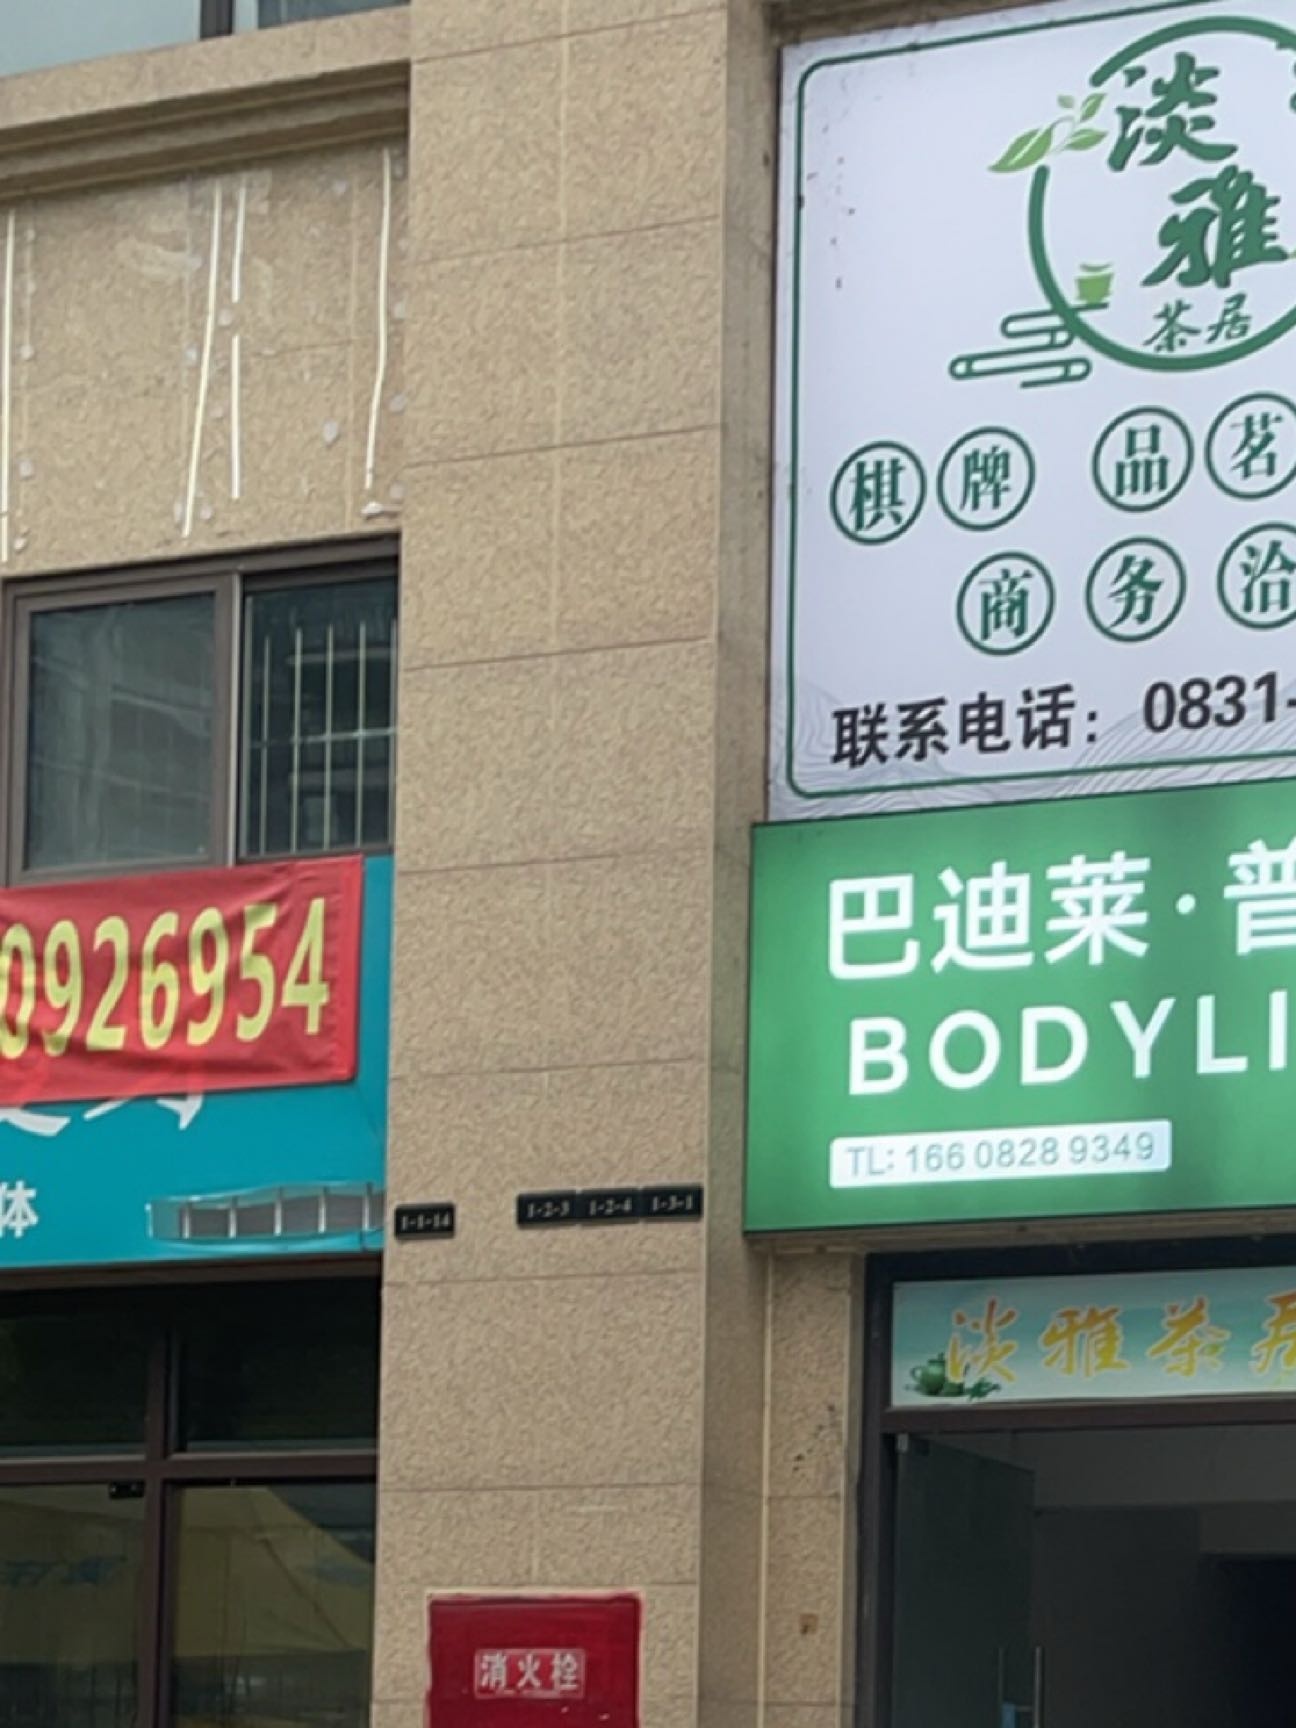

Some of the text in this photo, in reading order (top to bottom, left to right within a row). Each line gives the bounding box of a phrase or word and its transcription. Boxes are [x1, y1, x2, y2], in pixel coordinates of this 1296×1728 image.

[1108, 50, 1292, 290] 淡雅
[1142, 293, 1255, 354] 茶居
[845, 443, 1015, 534] 棋牌
[1112, 411, 1282, 497] 品茗
[0, 897, 331, 1060] 0926954
[905, 1142, 966, 1173] 166
[973, 1136, 1060, 1169] 0828
[1068, 1131, 1155, 1165] 9349
[479, 1652, 579, 1691] 消火栓
